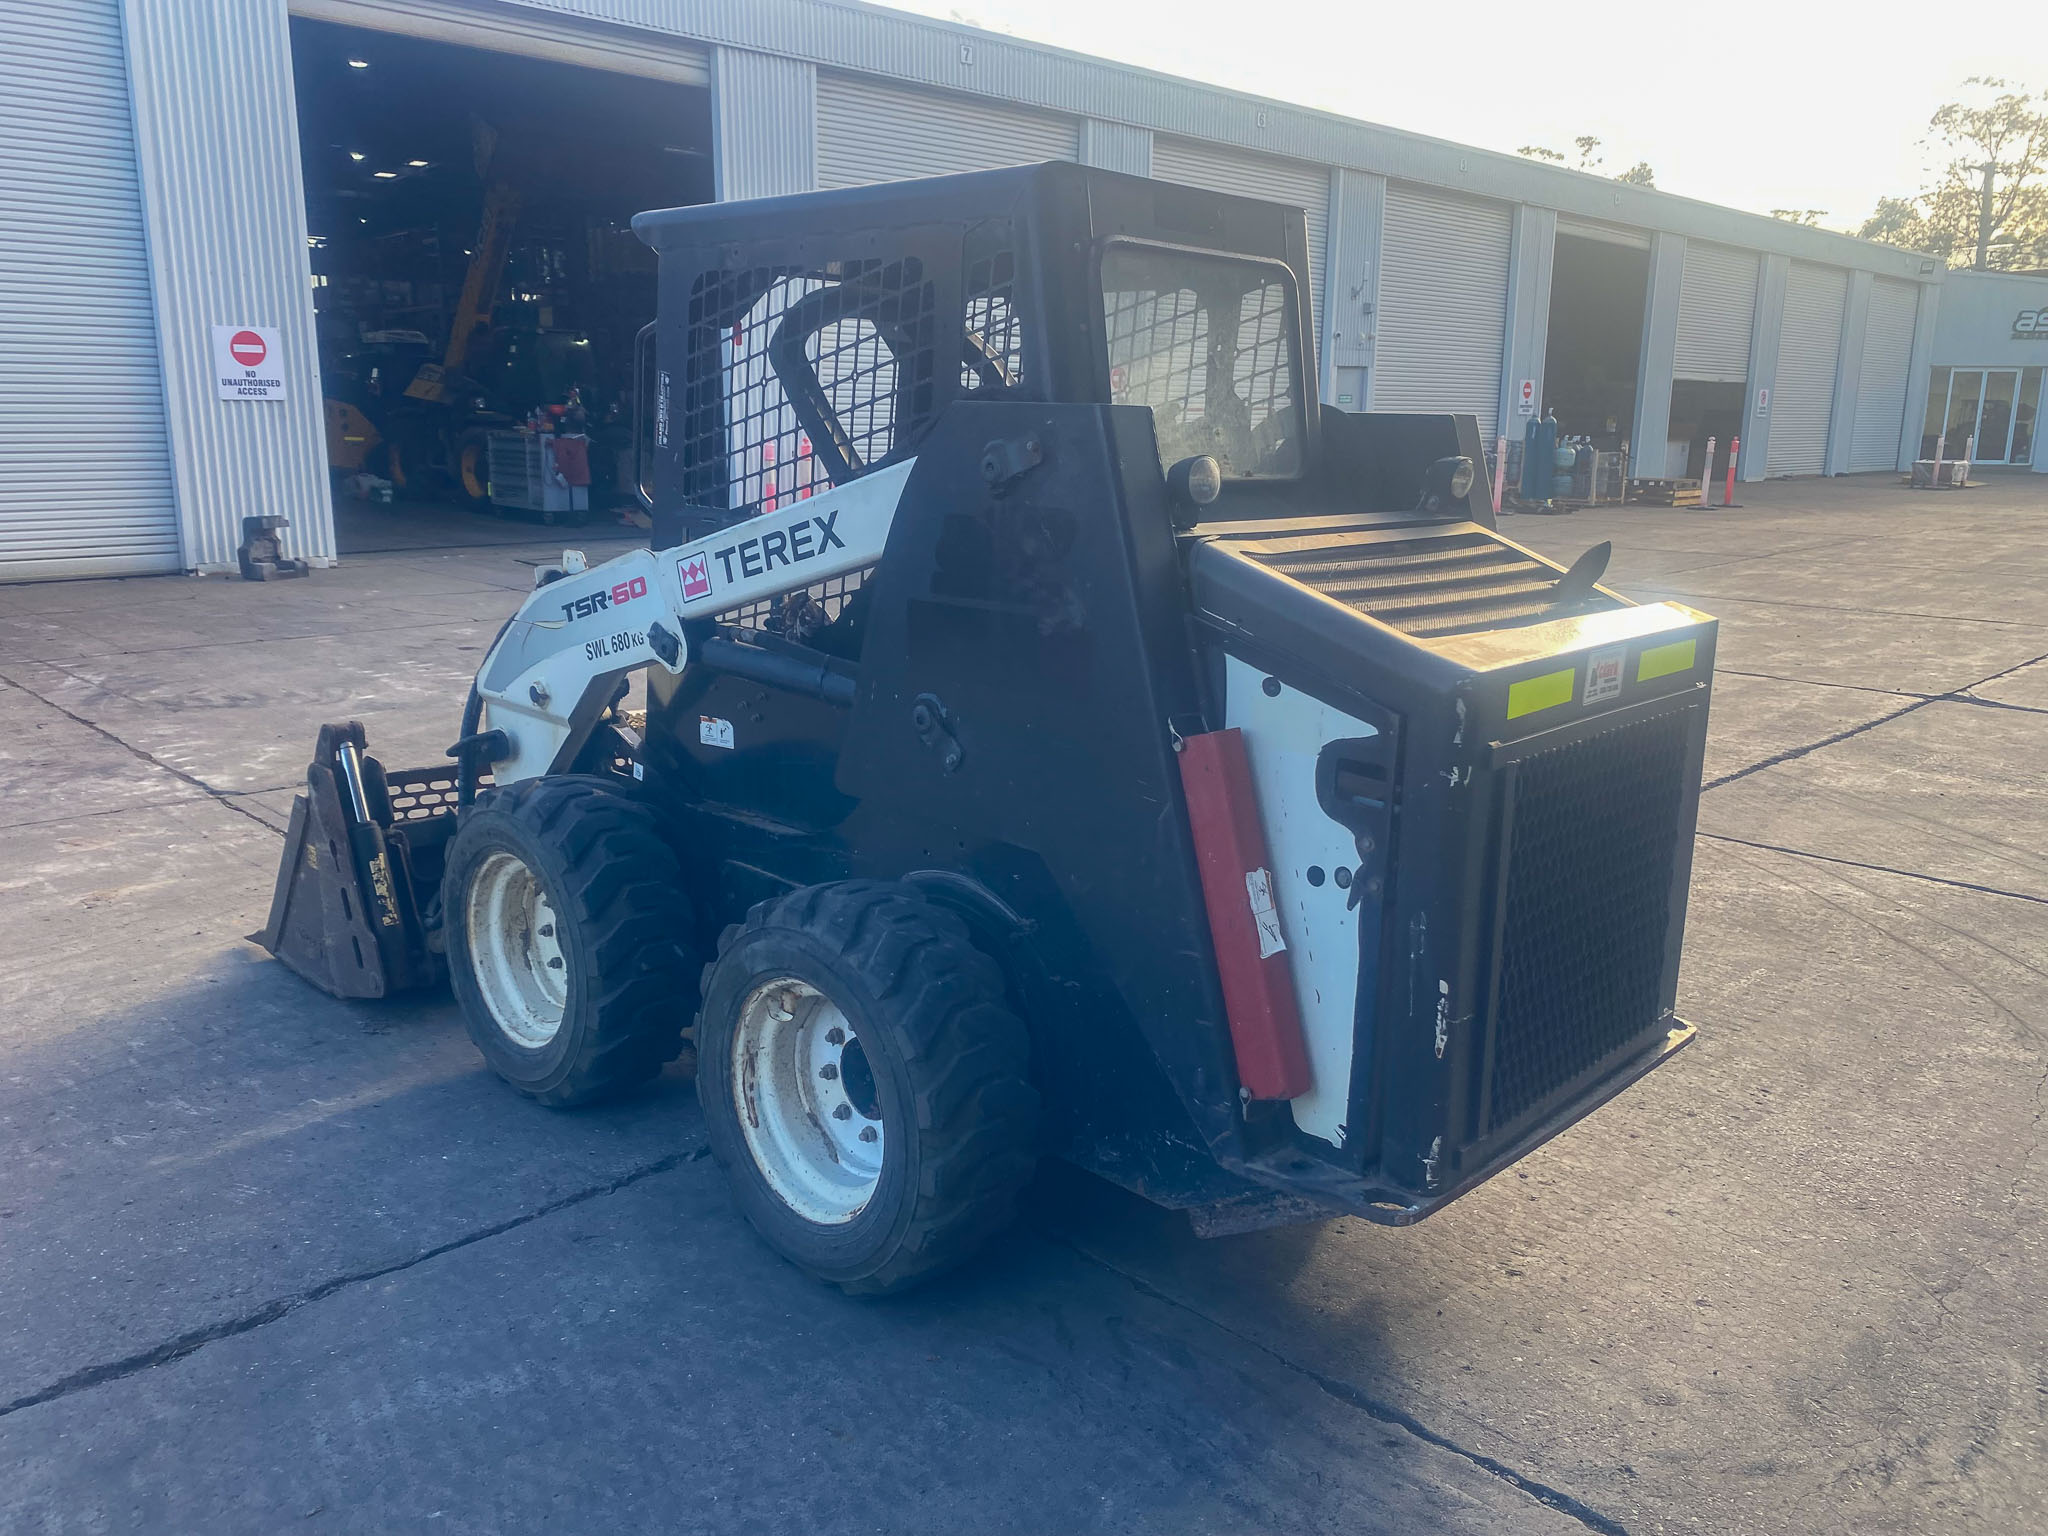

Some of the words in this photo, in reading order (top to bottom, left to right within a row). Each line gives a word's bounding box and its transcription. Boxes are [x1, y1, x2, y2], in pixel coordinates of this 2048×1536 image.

[963, 47, 970, 62] 7
[1259, 114, 1265, 126] 6
[245, 370, 256, 378] NO
[221, 378, 281, 387] UNAUTHORISED
[237, 387, 268, 396] ACCESS
[714, 510, 847, 584] TEREX
[561, 576, 648, 622] TSR-60
[585, 638, 610, 662] SWL
[611, 632, 631, 652] 680
[632, 631, 645, 646] KG
